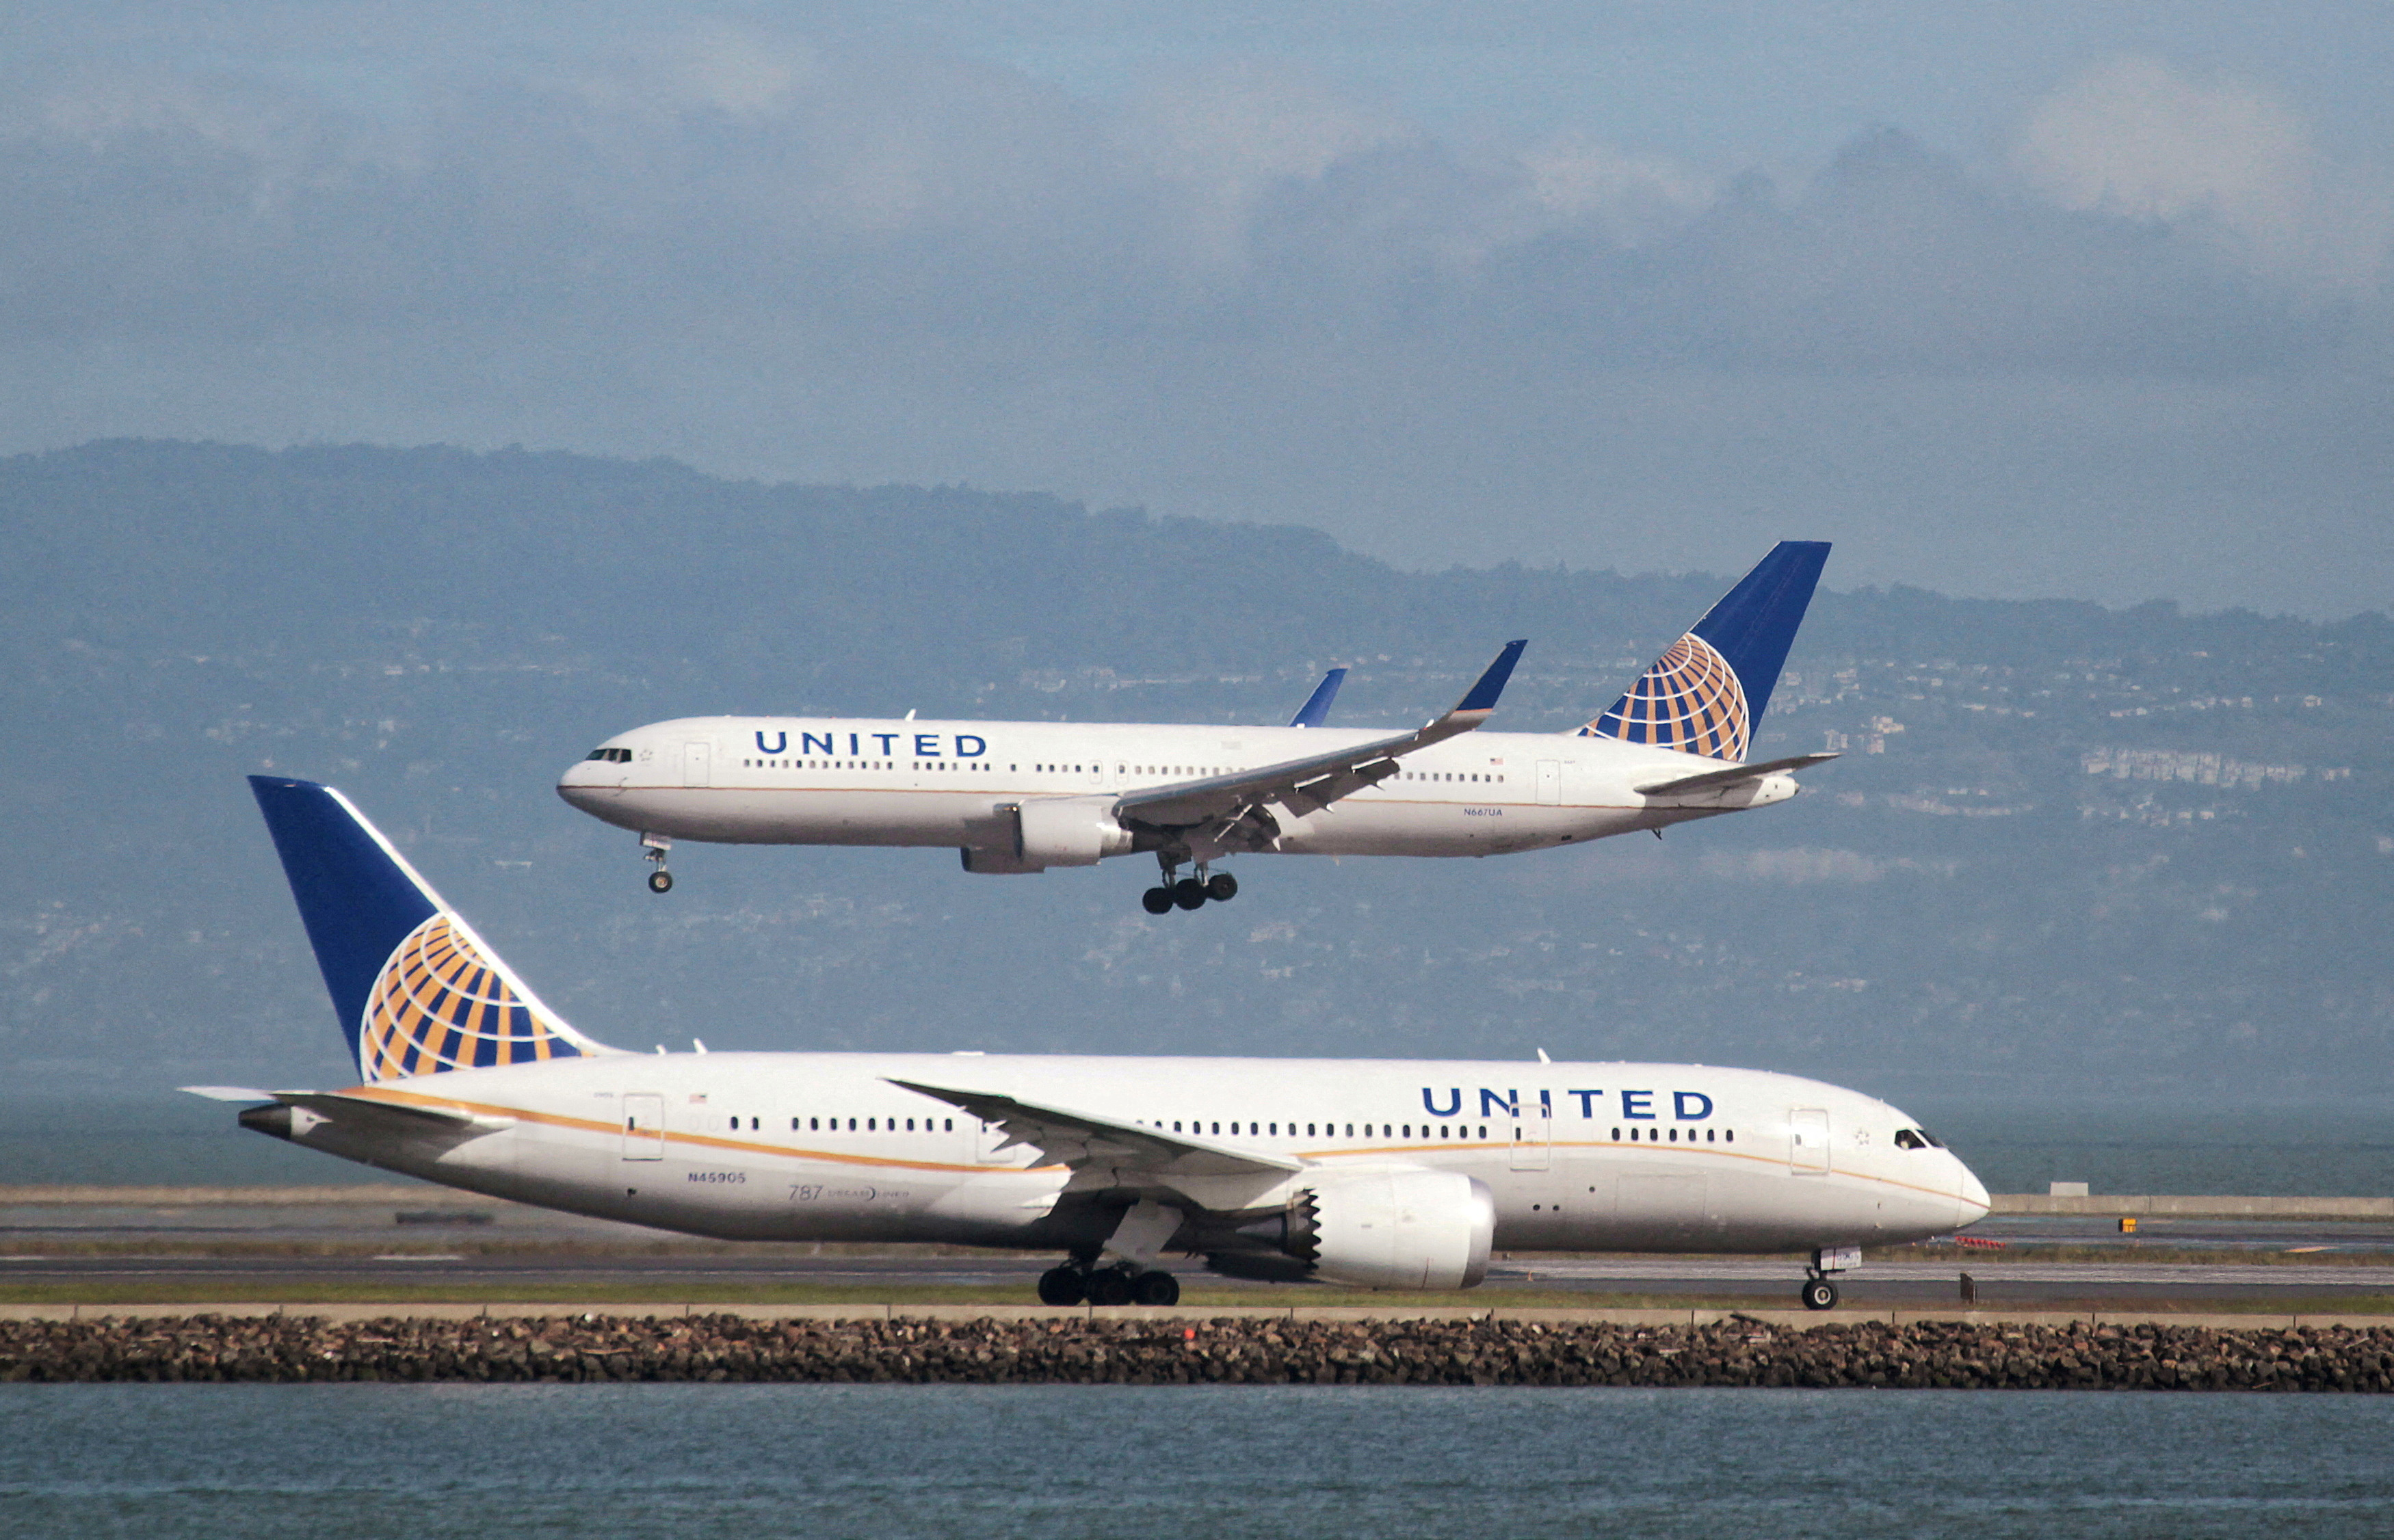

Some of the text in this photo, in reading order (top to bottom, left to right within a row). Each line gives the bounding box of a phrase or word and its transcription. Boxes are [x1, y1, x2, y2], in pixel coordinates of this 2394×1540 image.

[755, 731, 986, 757] UNITED
[1464, 808, 1503, 817] N667UA
[1422, 1087, 1713, 1120] UNITED
[688, 1172, 747, 1184] N45905
[789, 1184, 823, 1200] 787
